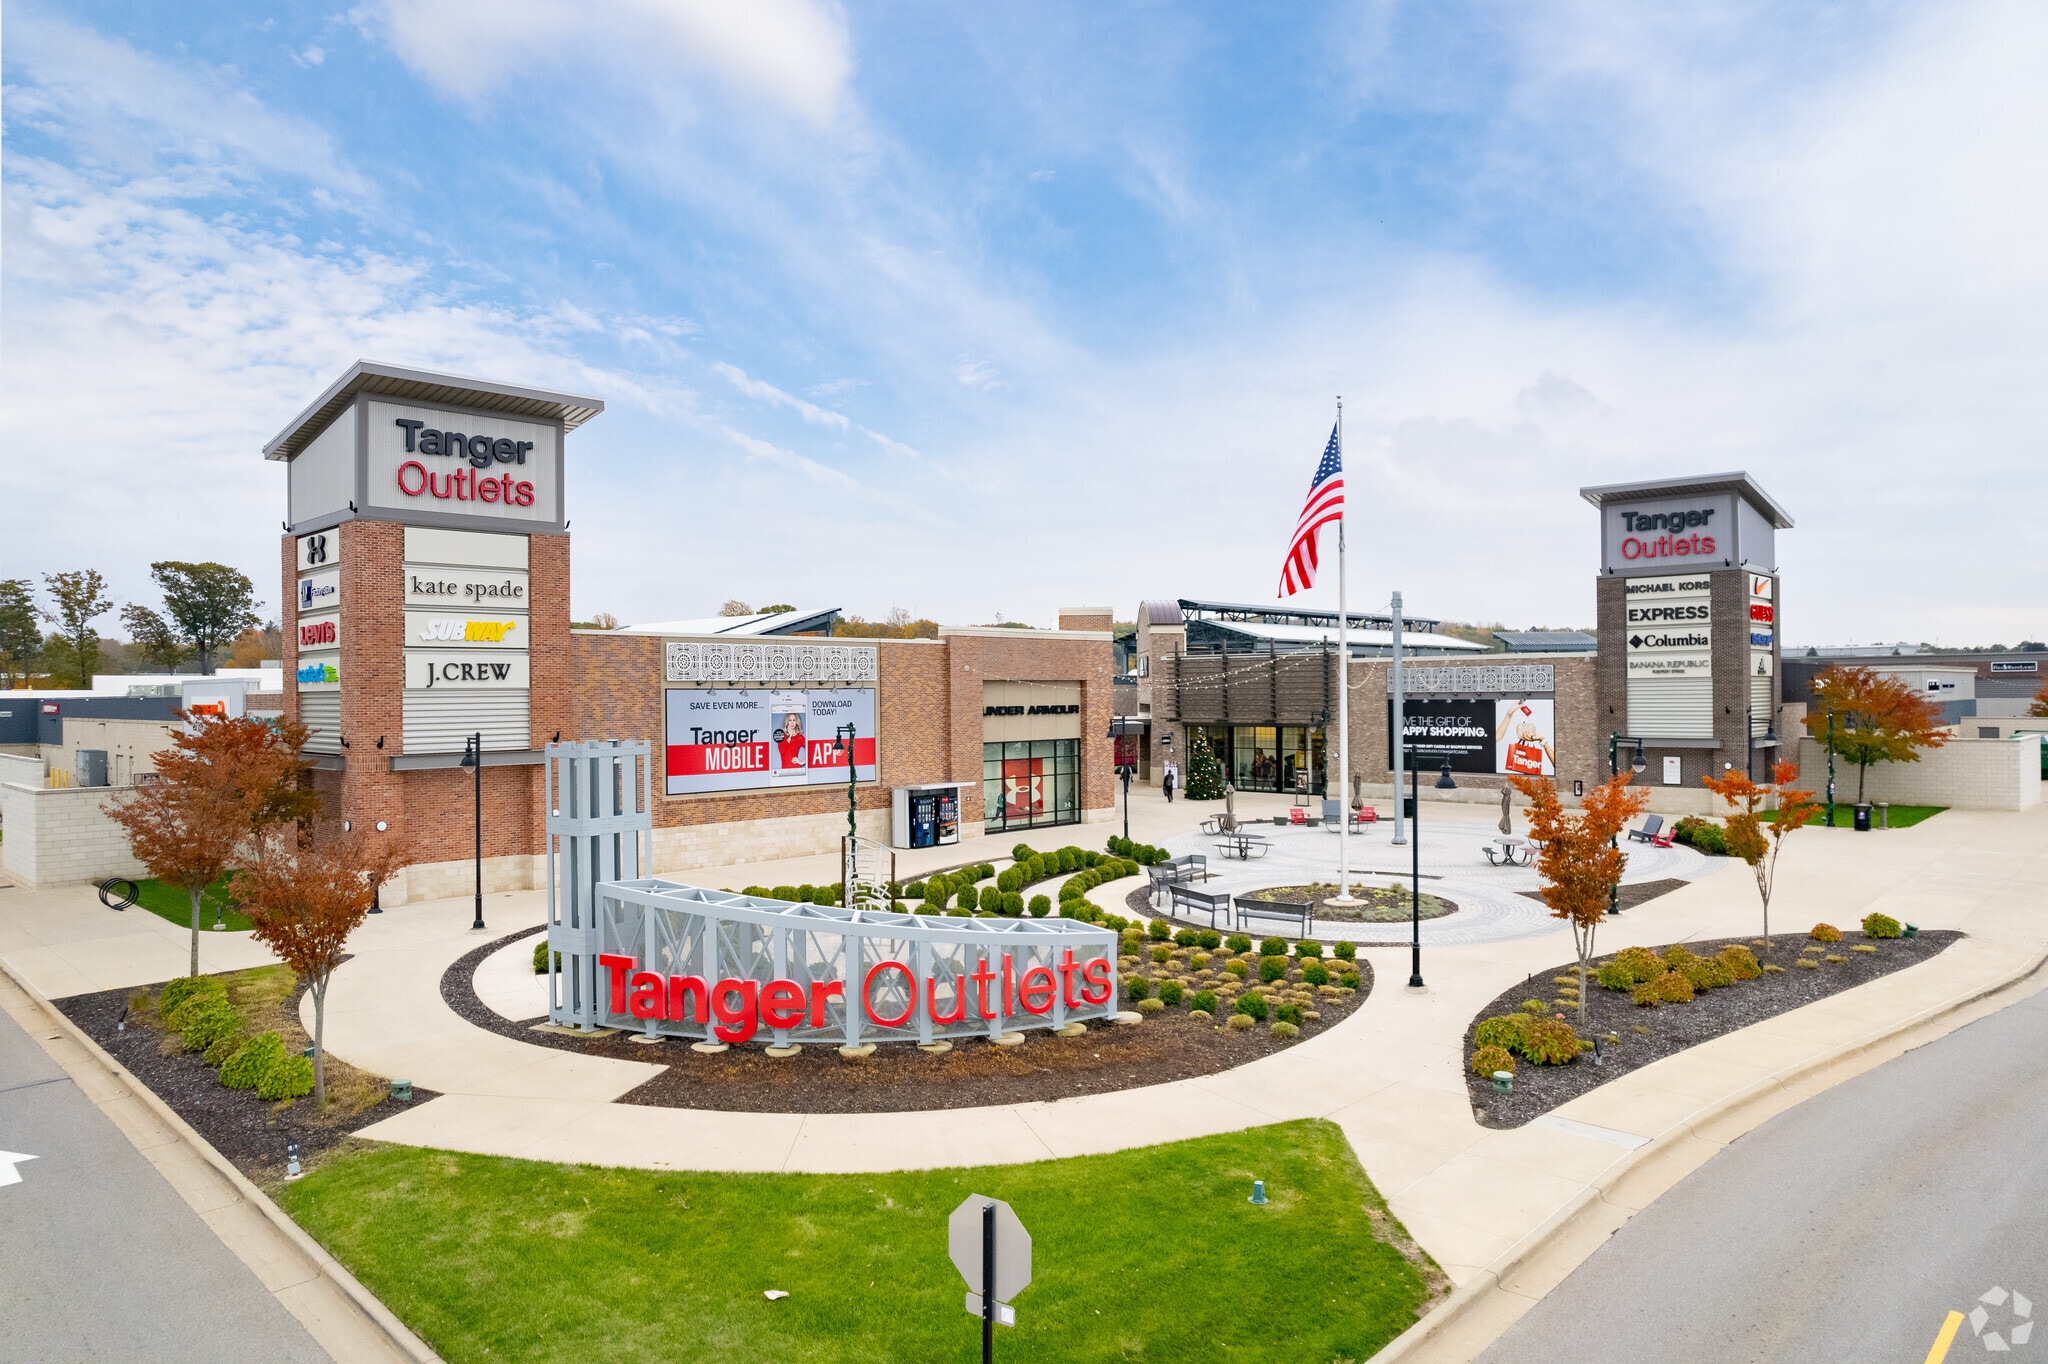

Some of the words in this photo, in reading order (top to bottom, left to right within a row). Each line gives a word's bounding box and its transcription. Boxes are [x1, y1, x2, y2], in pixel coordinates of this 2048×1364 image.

[396, 418, 533, 468] Tanger
[398, 461, 535, 506] Outlets
[1621, 509, 1714, 534] Tanger
[1621, 533, 1715, 560] Outlets
[411, 575, 457, 595] kate
[465, 580, 524, 602] spade
[1626, 583, 1675, 594] MICHAEL
[1679, 581, 1711, 591] KORS
[1628, 605, 1709, 621] EXPRESS
[420, 619, 516, 642] SUBWAY
[1644, 633, 1709, 648] Columbia
[1629, 661, 1666, 669] BANANA
[1667, 659, 1710, 668] REPUBLIC
[426, 662, 511, 688] J.CREW
[689, 702, 711, 710] SAVE
[712, 702, 734, 710] EVEN
[812, 700, 853, 708] DOWNLOAD
[812, 708, 837, 716] TODAY!
[1027, 704, 1080, 716] ARMOUR
[1417, 716, 1434, 726] THE
[1435, 716, 1456, 727] GIFT
[1457, 716, 1472, 727] OF
[690, 727, 758, 748] Tanger
[1403, 726, 1428, 736] APPY
[1429, 726, 1488, 738] SHOPPING.
[705, 745, 764, 771] MOBILE
[1513, 754, 1542, 769] Tanger
[599, 953, 844, 1043] Tanger
[863, 949, 1113, 1028] Outlets
